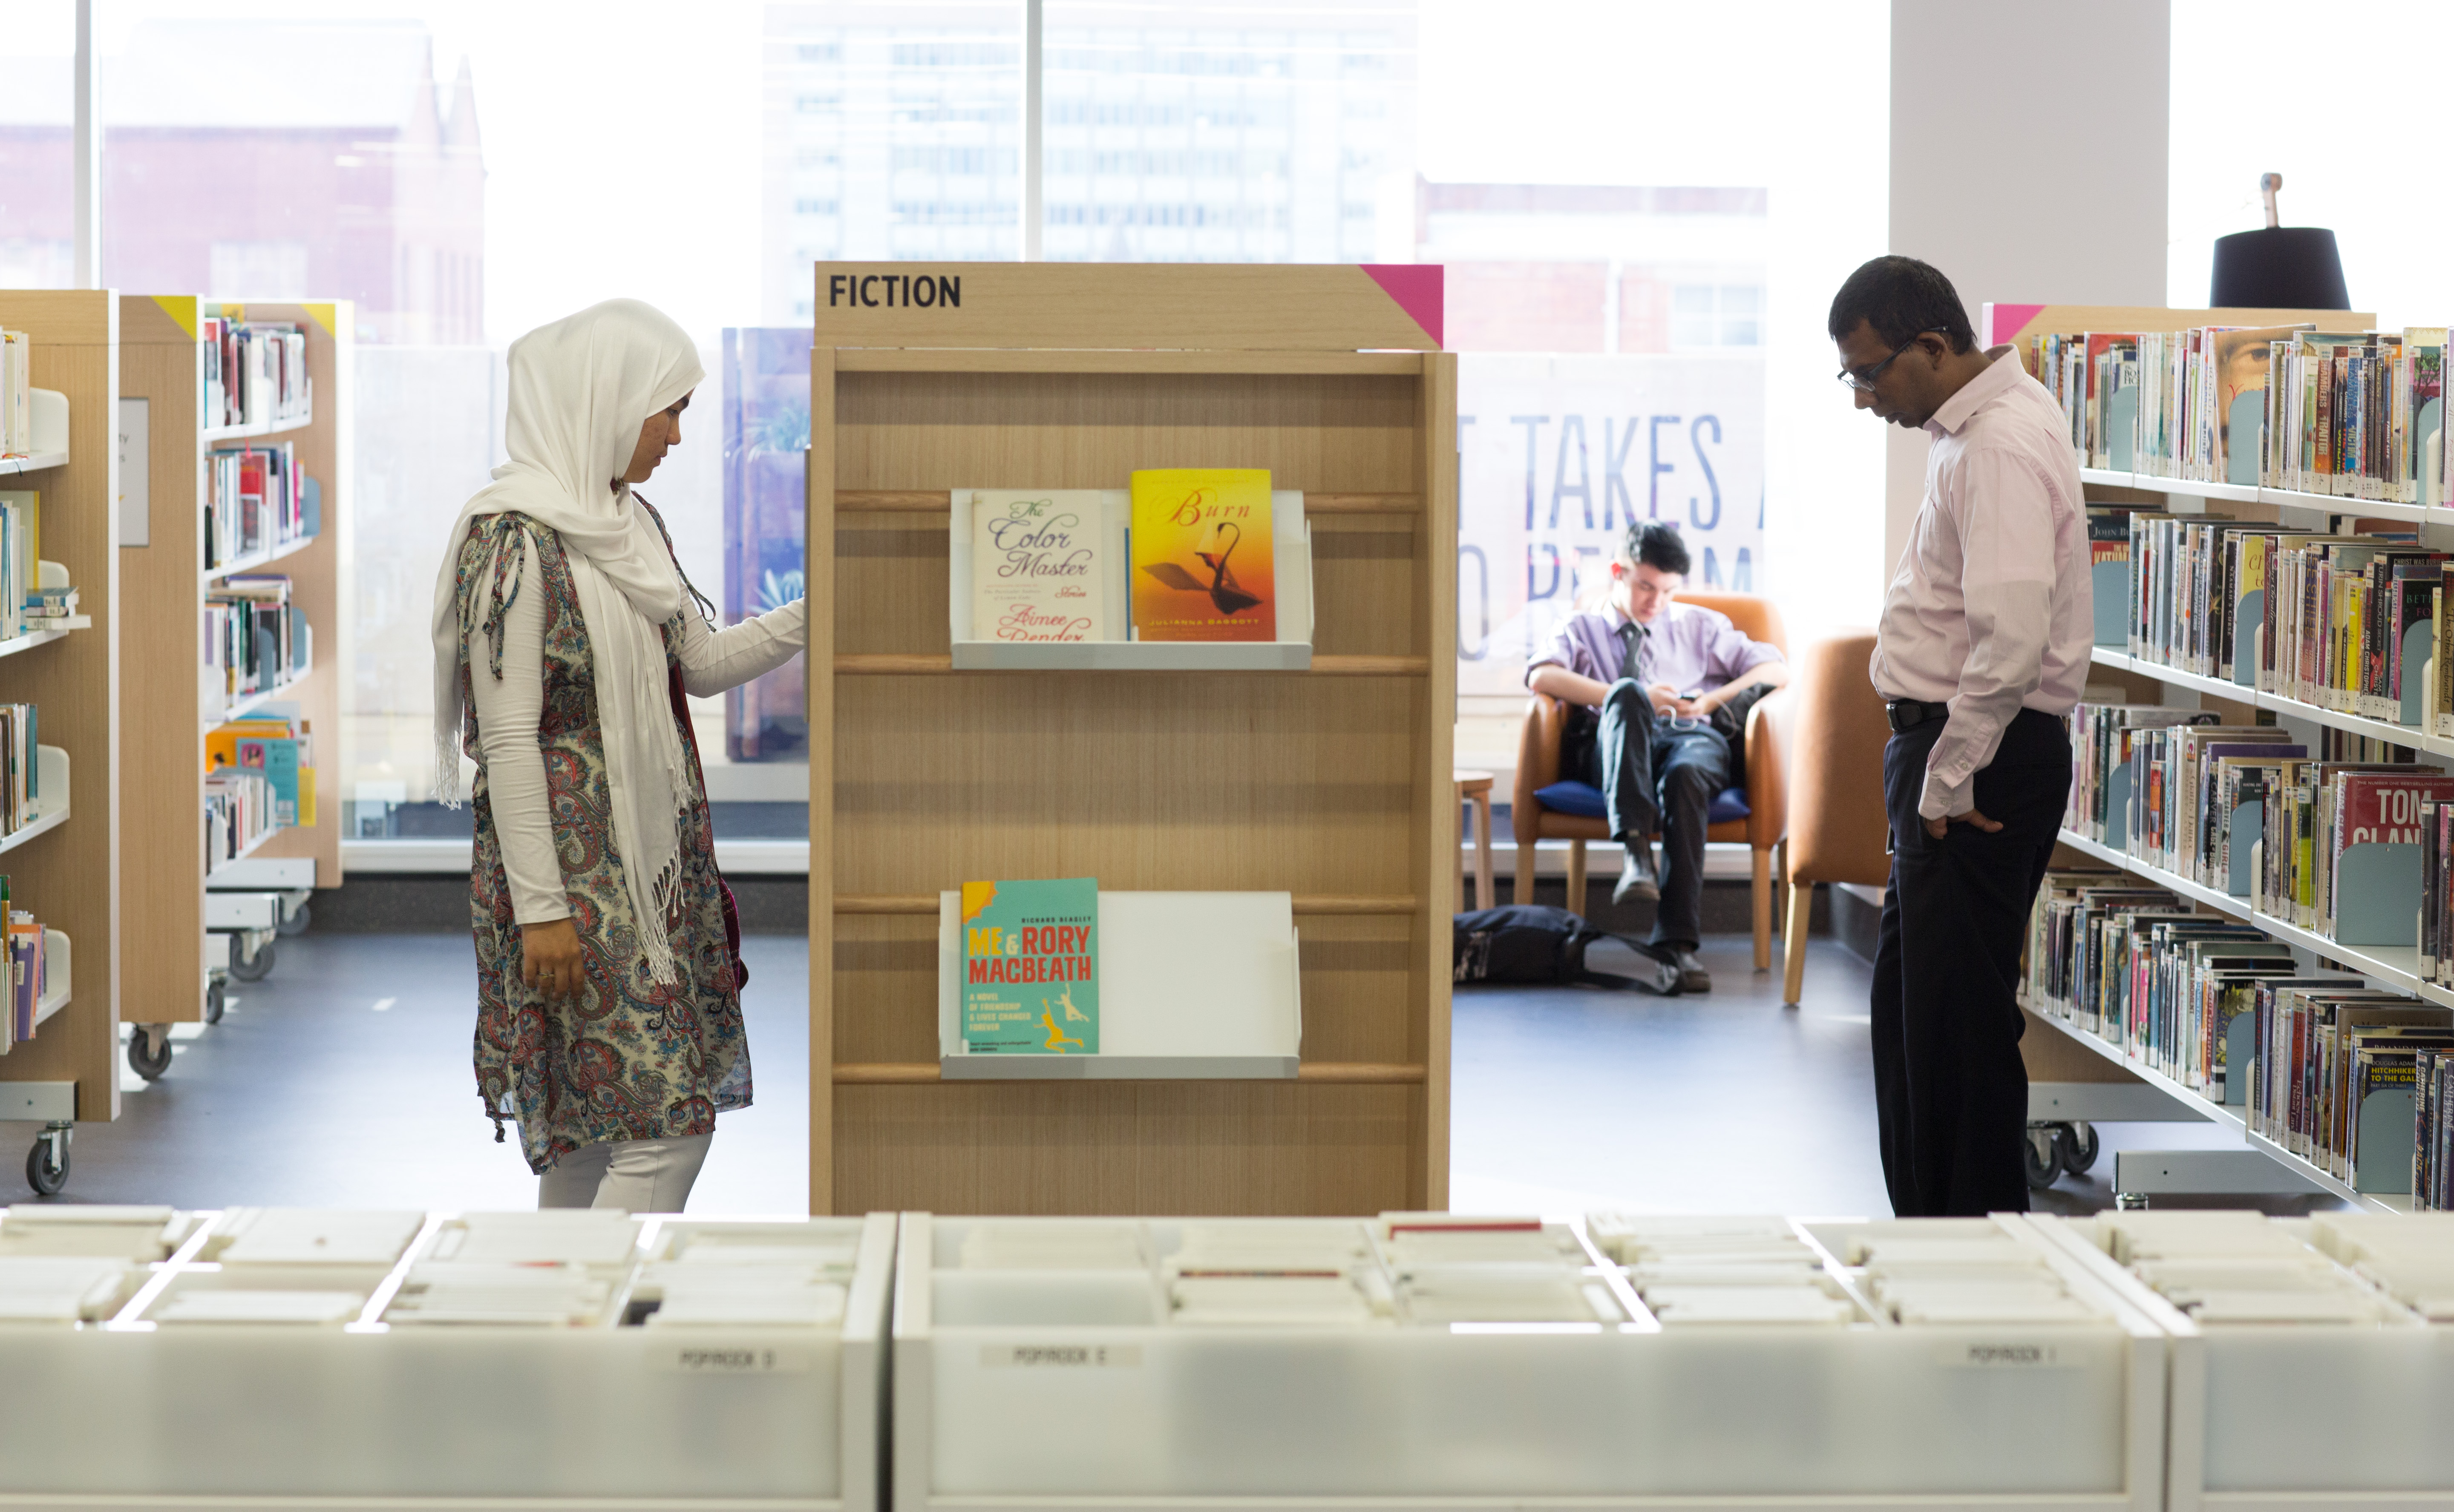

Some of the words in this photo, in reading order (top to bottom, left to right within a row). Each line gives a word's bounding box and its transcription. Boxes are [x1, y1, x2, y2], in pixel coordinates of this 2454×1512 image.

[830, 275, 960, 307] FICTION
[2347, 427, 2356, 458] VICTIM
[1510, 414, 1722, 532] TAKES
[1009, 499, 1052, 520] The
[1167, 487, 1250, 526] Burn
[988, 513, 1079, 551] Color
[997, 549, 1093, 578] Master
[999, 604, 1068, 627] Aimee
[2327, 649, 2330, 657] 61
[2445, 630, 2453, 655] Other
[2440, 658, 2453, 703] Rembrandt
[2376, 789, 2431, 825] TOM
[968, 927, 1002, 957] ME
[1005, 934, 1019, 955] &
[1022, 926, 1091, 955] RORY
[969, 956, 1092, 984] MACBEATH
[976, 993, 999, 1001] NOVEL
